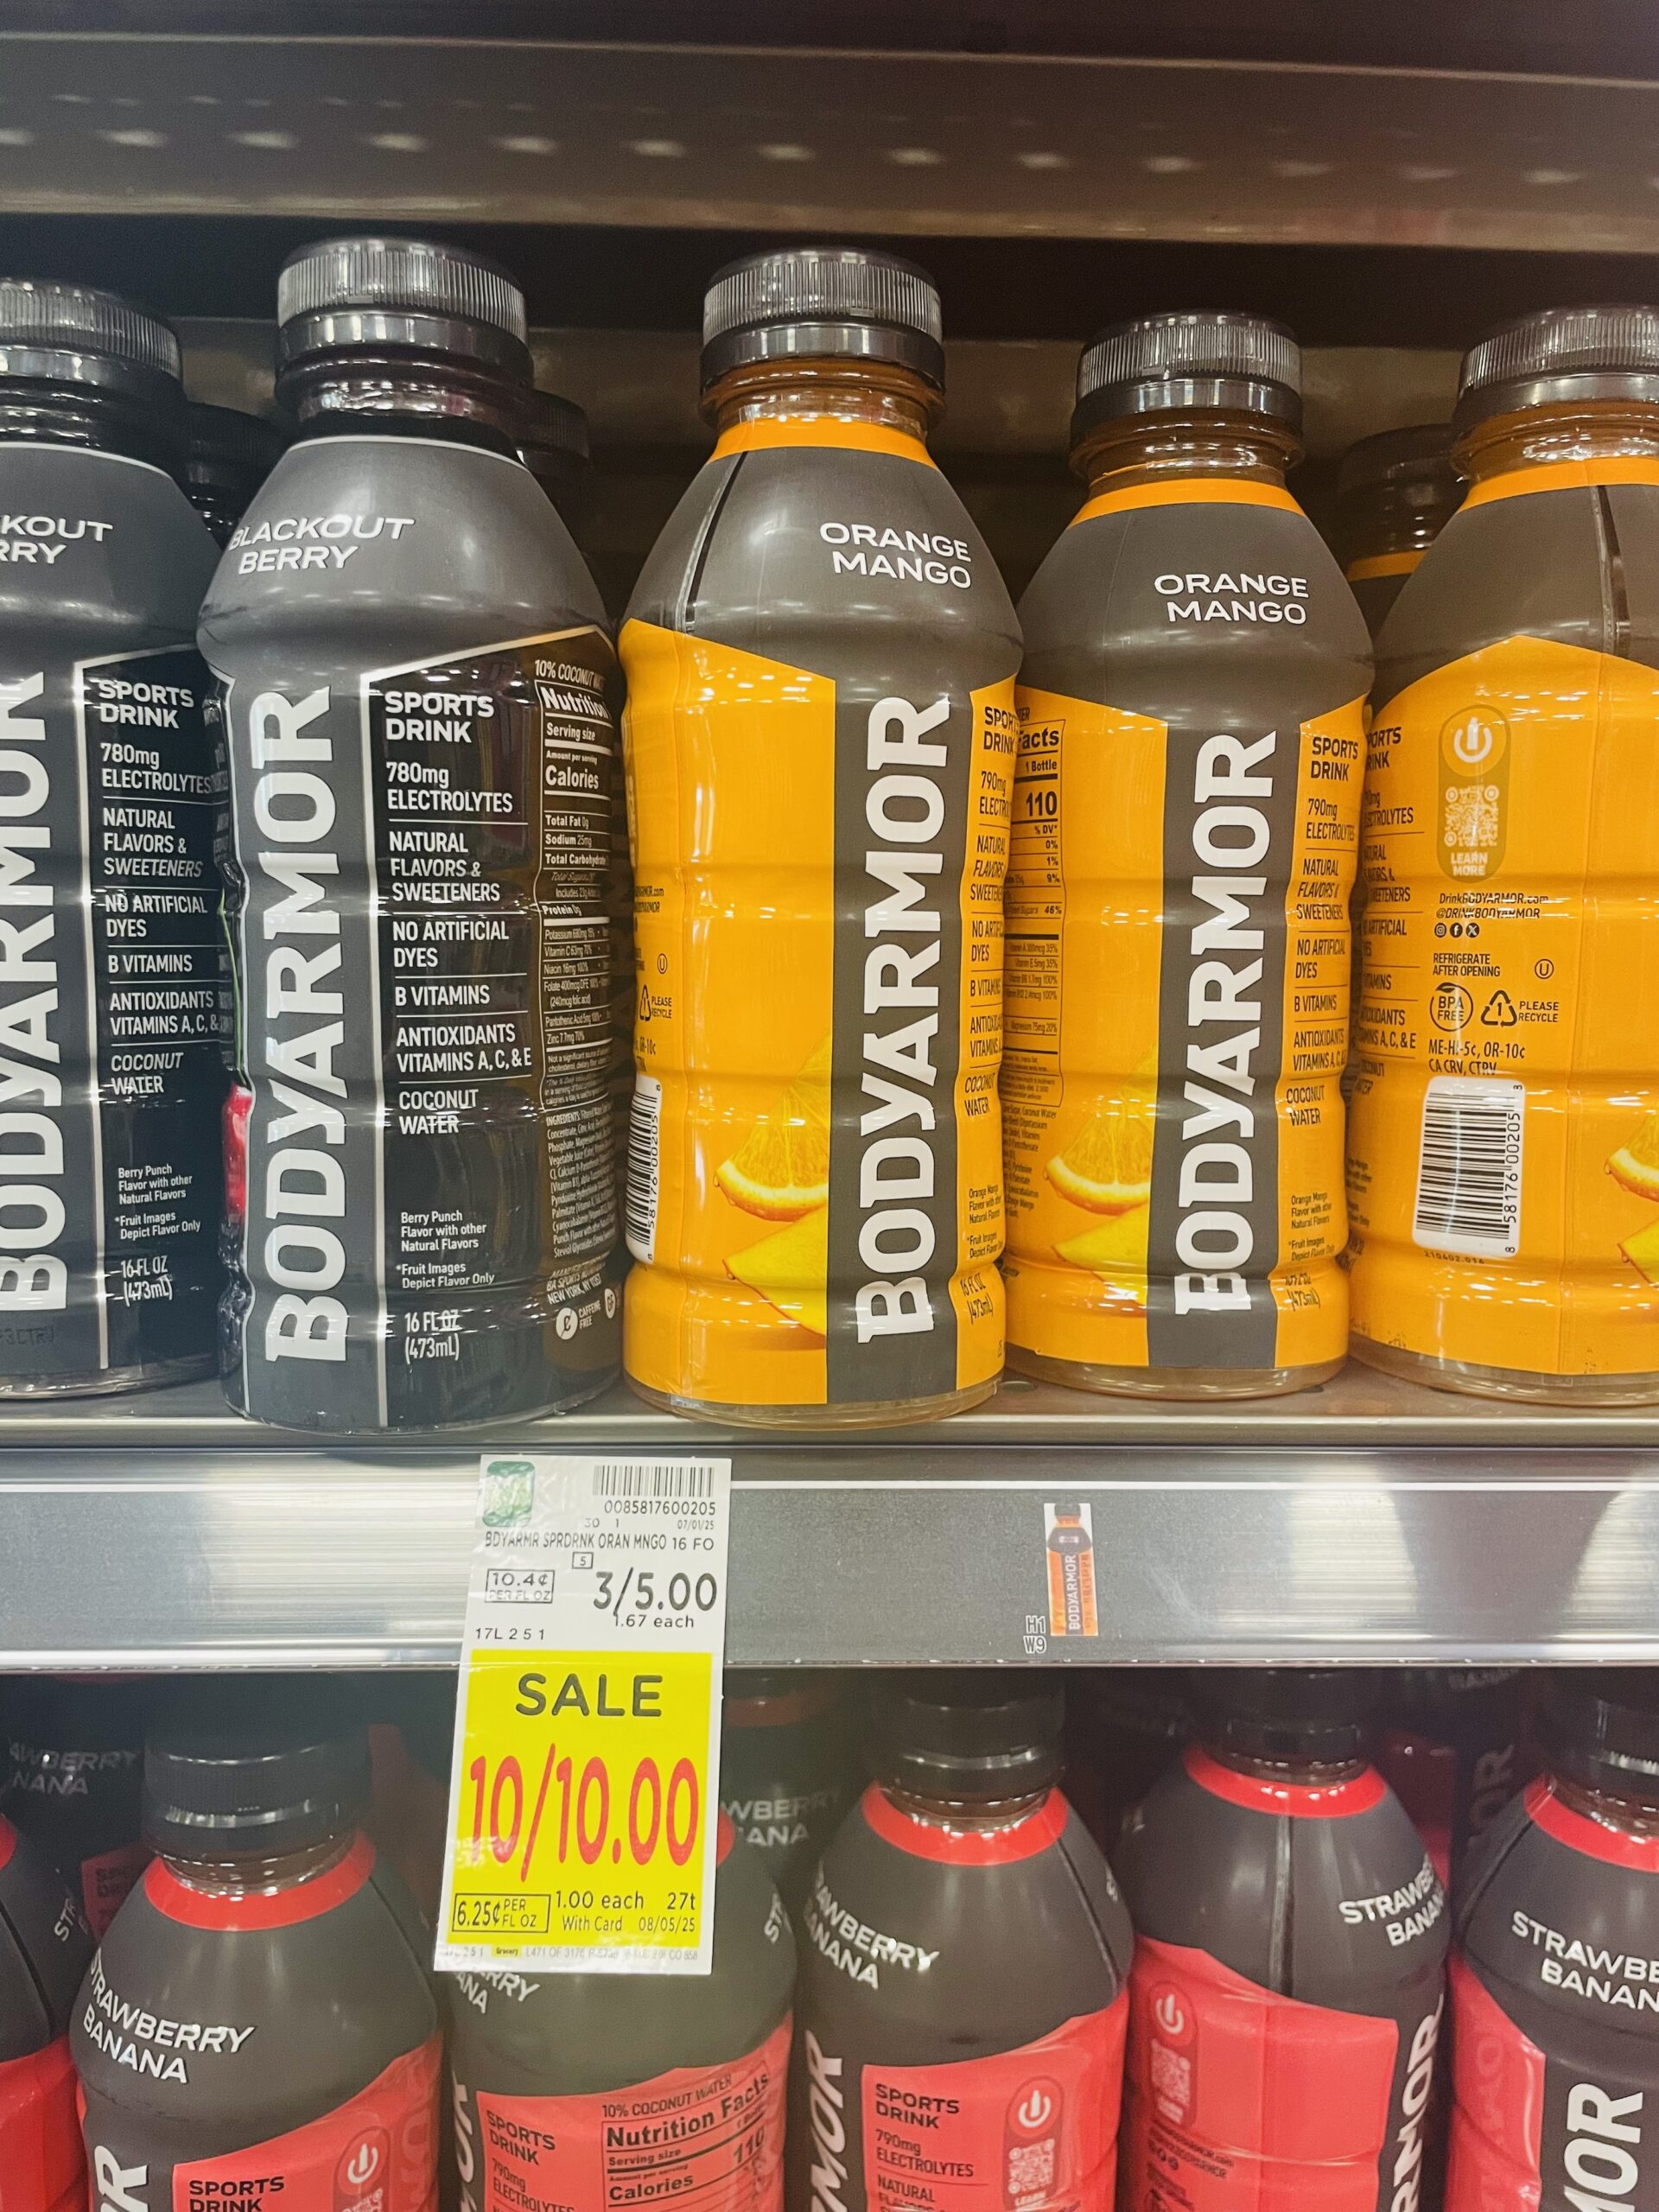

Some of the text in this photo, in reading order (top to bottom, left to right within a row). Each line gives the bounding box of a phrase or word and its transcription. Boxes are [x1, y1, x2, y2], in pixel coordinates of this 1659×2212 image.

[229, 515, 415, 550] BLACKOUT
[819, 522, 972, 563] ORANGE
[238, 546, 359, 574] BERRY
[833, 551, 971, 588] MANGO
[1154, 573, 1309, 598] ORANGE
[1166, 601, 1306, 624] MANGO
[535, 659, 594, 687] 10% COCONUT
[99, 680, 194, 708] SPORTS
[540, 687, 609, 719] Nutrition
[385, 692, 493, 718] SPORTS
[100, 703, 179, 728] DRINK
[386, 718, 472, 742] DRINK
[546, 722, 595, 741] Serving size
[100, 742, 159, 769] 780mg
[1313, 736, 1358, 760] SPORTS
[387, 761, 448, 788] 780mg
[1032, 759, 1057, 771] Bottle
[1311, 761, 1349, 781] DRINK
[102, 768, 211, 793] ELECTROLYTES
[546, 765, 599, 789] Calories
[388, 789, 512, 813] ELECTROLYTES
[1027, 791, 1058, 817] 110
[1308, 798, 1337, 820] 790mg
[103, 807, 175, 829] NATURAL
[545, 814, 581, 827] Total Fat
[390, 831, 467, 853] NATURAL
[545, 833, 576, 845] Sodium
[1306, 823, 1354, 842] ELECTROLYTES
[104, 832, 174, 854] FLAVORS
[391, 858, 480, 876] FLAVORS &
[1303, 859, 1338, 876] NATURAL
[1451, 851, 1488, 864] LEARN
[104, 858, 202, 878] SWEETENERS
[1452, 864, 1485, 876] MORE
[392, 883, 500, 901] SWEETENERS
[133, 895, 207, 913] ARTIFICIAL
[543, 906, 572, 915] Protein
[107, 919, 147, 937] DYES
[393, 921, 509, 941] NO ARTIFICIAL
[394, 948, 438, 967] DYES
[971, 944, 989, 961] DYES
[1298, 939, 1311, 956] NO
[123, 954, 192, 973] VITAMINS
[1433, 953, 1491, 964] REFRIGERATE
[1296, 962, 1317, 979] DYES
[1433, 965, 1500, 976] AFTER OPENING
[110, 991, 213, 1011] ANTIOXIDANTS
[396, 985, 490, 1006] B VITAMINS
[652, 996, 671, 1007] PLEASE
[1294, 995, 1337, 1012] B VITAMINS
[1438, 996, 1464, 1009] BPA
[651, 1008, 671, 1018] RECYCLE
[1437, 1010, 1464, 1021] FREE
[1520, 1001, 1559, 1011] PLEASE
[250, 685, 349, 1363] BODYARMOR
[857, 695, 950, 1343] BODYARMOR
[1175, 729, 1276, 1315] BODYARMOR
[1518, 1014, 1558, 1022] RECYCLE
[397, 1023, 515, 1046] ANTIOXIDANTS
[1294, 1028, 1344, 1048] ANTIOXIDANTS
[111, 1052, 183, 1071] COCONUT
[397, 1052, 474, 1072] VITAMINS
[1429, 1058, 1441, 1072] CA
[399, 1090, 478, 1110] COCONUT
[1287, 1084, 1325, 1103] COCONUT
[399, 1115, 459, 1135] WATER
[1289, 1108, 1320, 1127] WATER
[118, 1165, 171, 1179] Berry Punch
[401, 1211, 462, 1225] Berry Punch
[401, 1224, 486, 1238] Flavor with other
[401, 1237, 479, 1252] Natural Flavors
[429, 1262, 466, 1274] Images
[402, 1273, 494, 1289] Depict Flavor Only
[405, 1310, 460, 1332] 16 FL OZ
[405, 1333, 459, 1364] (473mL)
[604, 1499, 716, 1516] 0085817600205
[677, 1520, 714, 1530] 07/01/25
[485, 1531, 714, 1550] BDYARMR SPRDRNK ORAN MNGO 16 FO
[534, 1591, 551, 1601] OZ
[593, 1567, 718, 1617] 3/5.00
[1065, 1554, 1081, 1630] BODYARMOR
[614, 1614, 695, 1628] 1.67 each
[516, 1673, 664, 1717] SALE
[470, 1743, 699, 1882] 10/10.00
[504, 1899, 526, 1911] PER
[556, 1891, 696, 1910] 1.00 each 27t
[502, 1915, 537, 1928] FL OZ
[563, 1915, 696, 1935] With Card 08/05/25
[90, 1947, 255, 2053] STRAWBERRY
[83, 2003, 188, 2084] BANANA
[601, 2075, 732, 2118] 10% COCONUT WATER
[875, 2082, 960, 2114] SPORTS
[607, 2073, 769, 2147] Nutrition Facts
[875, 2101, 939, 2129] DRINK
[486, 2109, 556, 2152] SPORTS
[489, 2129, 539, 2165] DRINK
[875, 2128, 921, 2157] 790mg
[608, 2148, 682, 2166] Serving size
[876, 2147, 974, 2177] ELECTROLYTES
[188, 2176, 285, 2196] SPORTS
[608, 2176, 694, 2202] Calories
[877, 2174, 936, 2202] NATURAL
